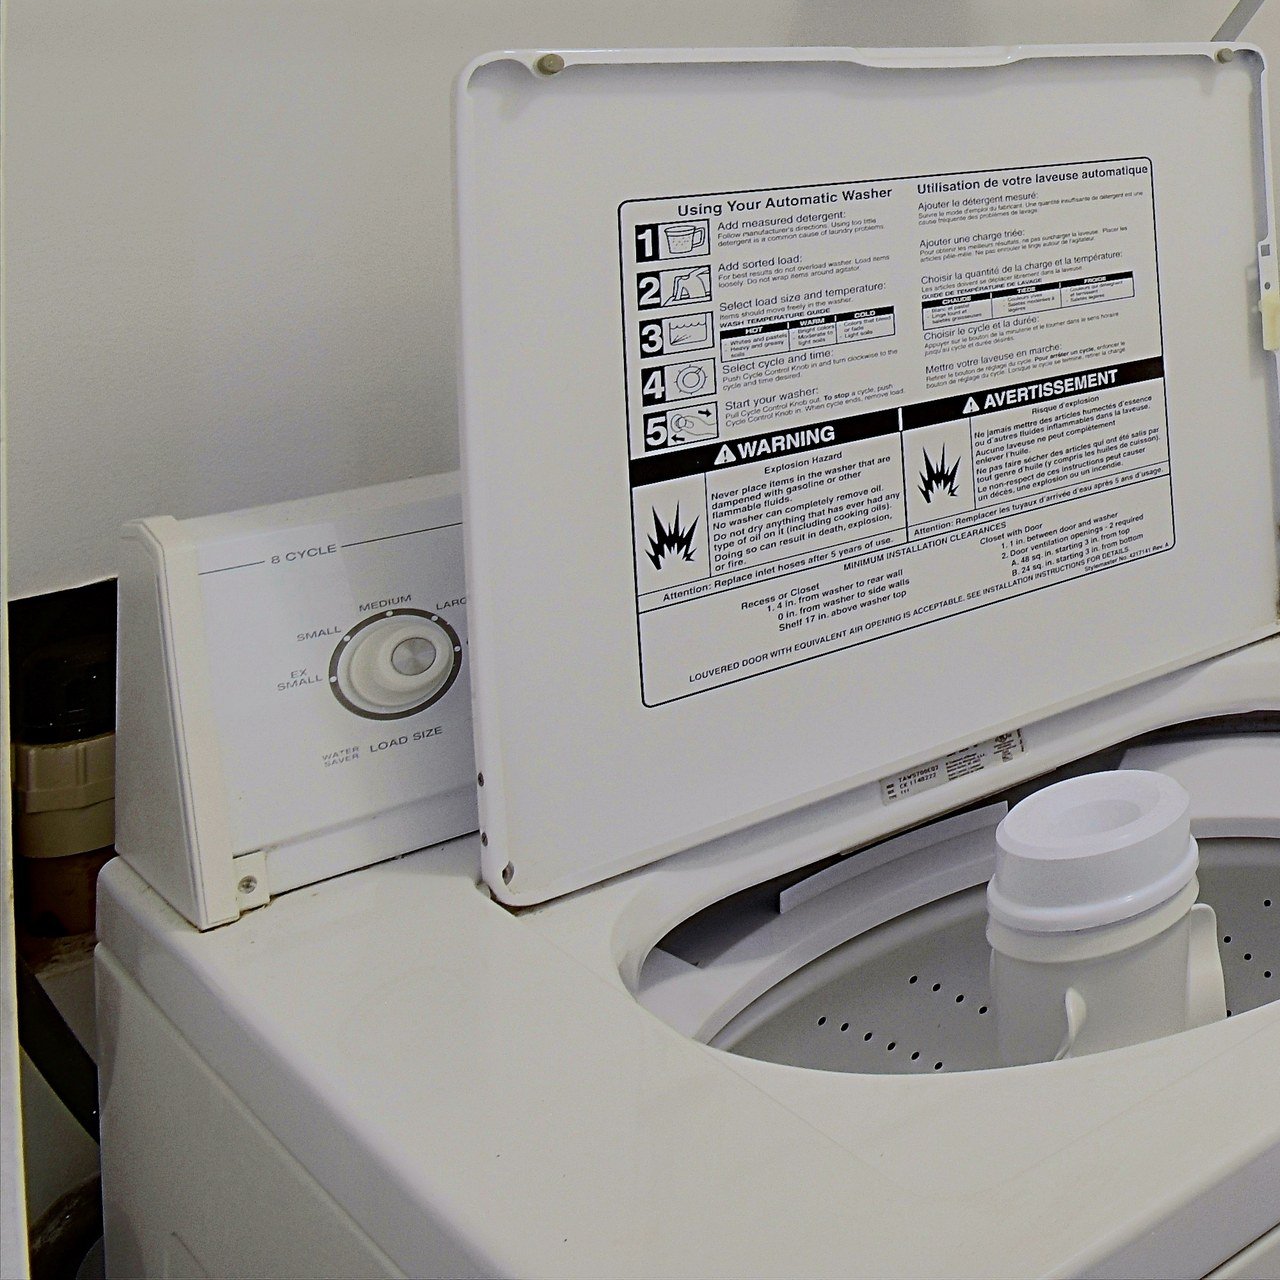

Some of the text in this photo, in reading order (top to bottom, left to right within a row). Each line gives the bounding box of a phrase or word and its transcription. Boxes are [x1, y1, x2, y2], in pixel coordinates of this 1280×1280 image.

[917, 165, 1148, 194] Utilisation de votre laveuse automatique
[677, 187, 892, 217] Using Your Automatic Washer
[717, 211, 845, 231] Add measured detergent:
[637, 229, 653, 257] 1
[717, 254, 802, 272] Add sorted load:
[638, 277, 660, 305] 2
[719, 282, 886, 312] Select load size and temperature:
[641, 325, 663, 353] 3
[722, 349, 833, 374] Select cycle and time:
[643, 371, 665, 399] 4
[984, 369, 1118, 410] AVERTISSEMENT
[725, 387, 818, 411] Start your washer:
[1031, 395, 1099, 415] Risque d'explosion
[646, 417, 668, 446] 5
[737, 425, 836, 459] WARNING
[764, 451, 842, 474] Explosion Hazard
[711, 456, 891, 501] Never place items in the washer that are
[711, 470, 861, 510] dampened with gasoline or other
[712, 494, 792, 519] flammable fluids.
[843, 521, 1006, 571] MINIMUM INSTALLATION CLEARANCES
[979, 523, 1043, 545] Closet with Door
[271, 544, 338, 564] 8 CYCLE
[662, 537, 893, 602] Attention: Replace inlet hoses after 5 years of use.
[358, 594, 412, 612] MEDIUM
[741, 582, 819, 610] Recess or Closet
[296, 626, 342, 643] SMALL
[277, 675, 323, 692] SMALL
[290, 669, 308, 679] EX
[321, 745, 360, 761] WATER
[369, 726, 444, 753] LOAD SIZE
[323, 753, 360, 768] SAVER
